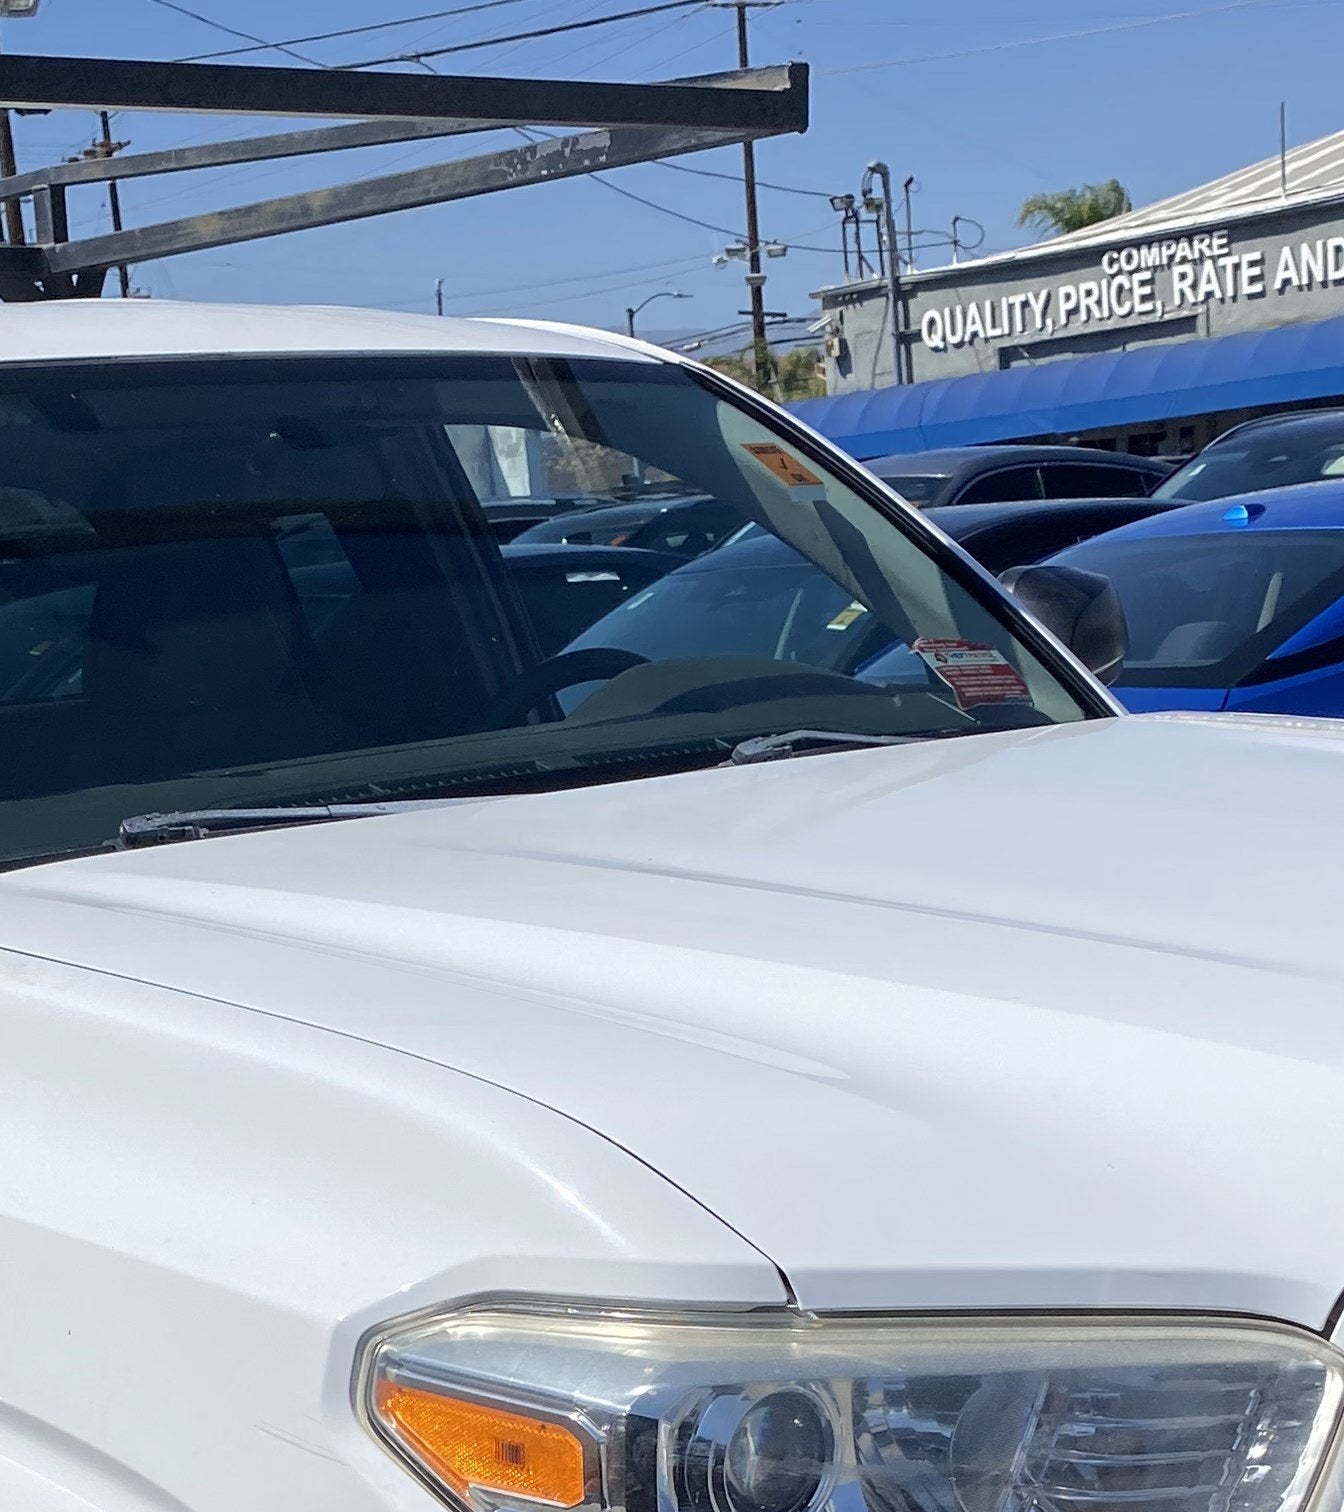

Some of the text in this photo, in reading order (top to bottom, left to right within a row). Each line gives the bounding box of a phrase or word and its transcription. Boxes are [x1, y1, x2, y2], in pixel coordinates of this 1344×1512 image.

[1102, 229, 1229, 275] COMPARE
[921, 288, 1054, 349] QUALITY,
[1058, 270, 1164, 326] PRICE,
[1172, 251, 1264, 306] RATE
